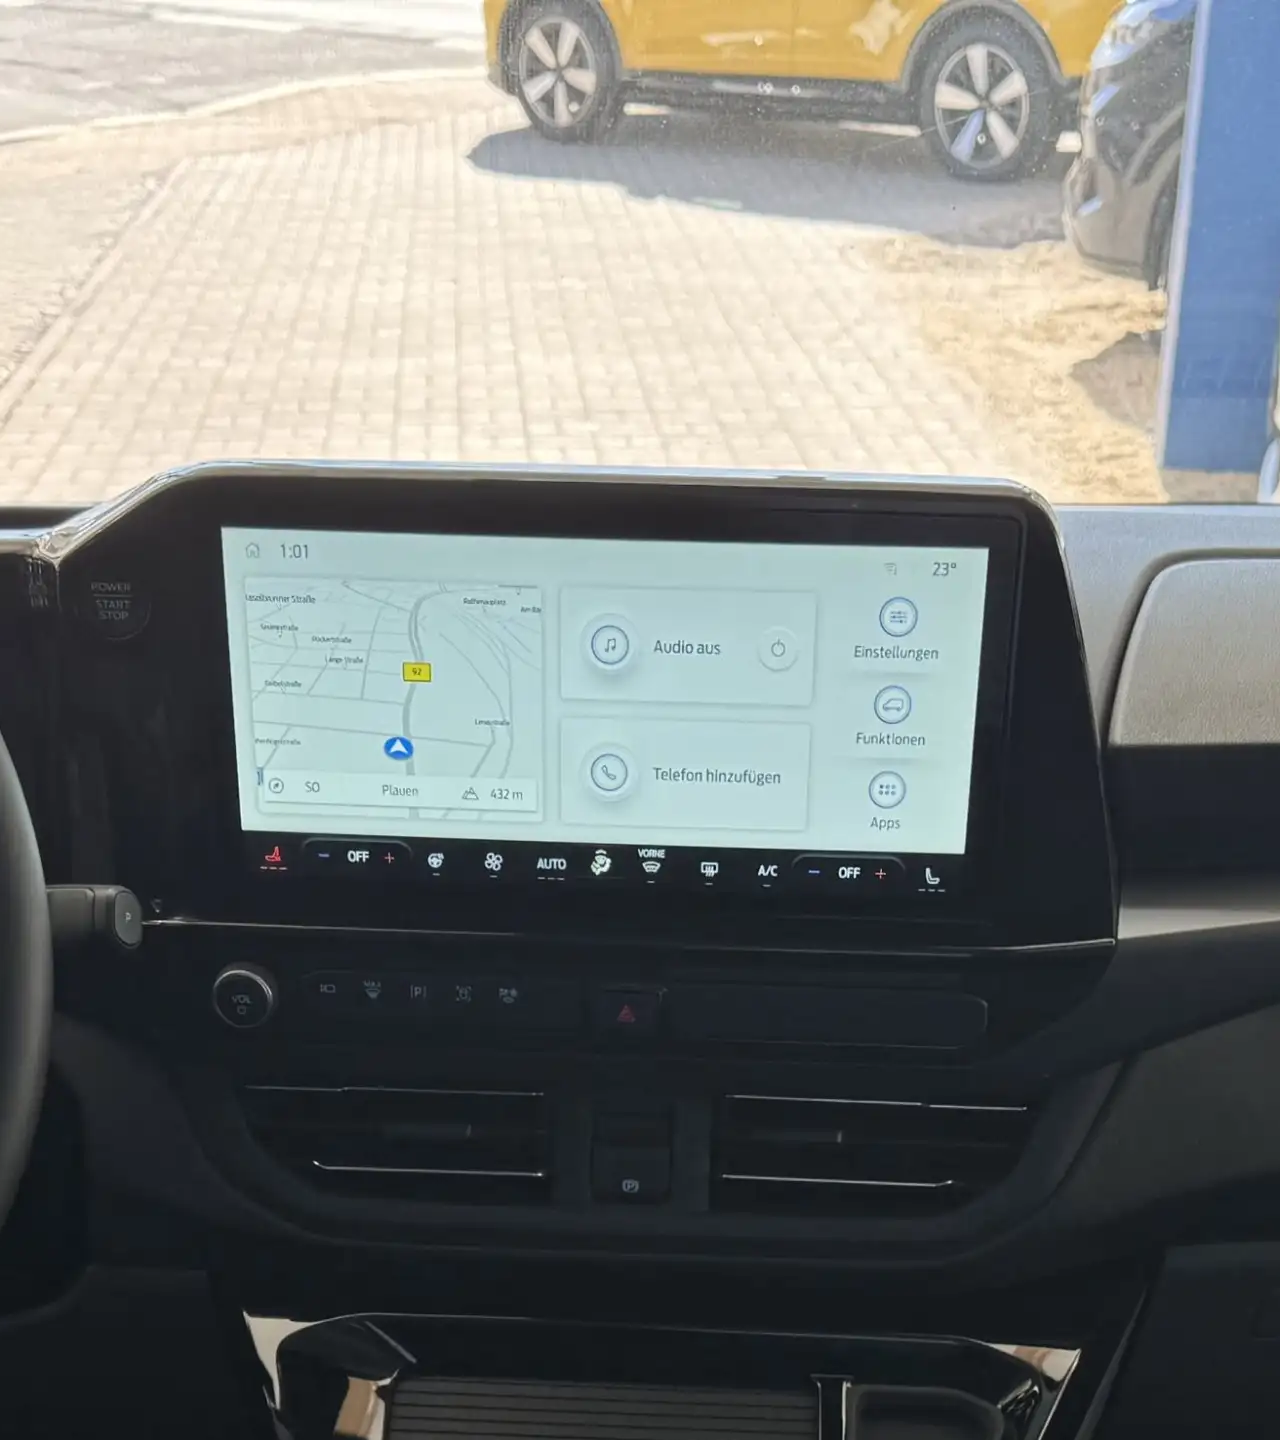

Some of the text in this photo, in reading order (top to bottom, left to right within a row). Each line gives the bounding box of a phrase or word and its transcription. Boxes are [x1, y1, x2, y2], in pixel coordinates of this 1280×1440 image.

[280, 544, 309, 558] 1:01
[933, 562, 957, 577] 23°
[90, 582, 131, 592] POWER
[96, 600, 132, 609] START
[99, 610, 129, 620] STOP
[653, 639, 721, 656] Audio aus
[854, 645, 939, 662] Einstellungen
[412, 667, 422, 676] 92
[856, 732, 926, 747] Funktionen
[653, 767, 781, 787] Telefon hinzufügen
[382, 784, 418, 797] Plauen
[490, 788, 523, 800] 432 m
[870, 816, 901, 831] Apps
[347, 850, 370, 864] OFF
[638, 848, 666, 859] VORNE
[537, 858, 566, 870] AUTO
[757, 864, 778, 877] A/C
[838, 867, 860, 880] OFF
